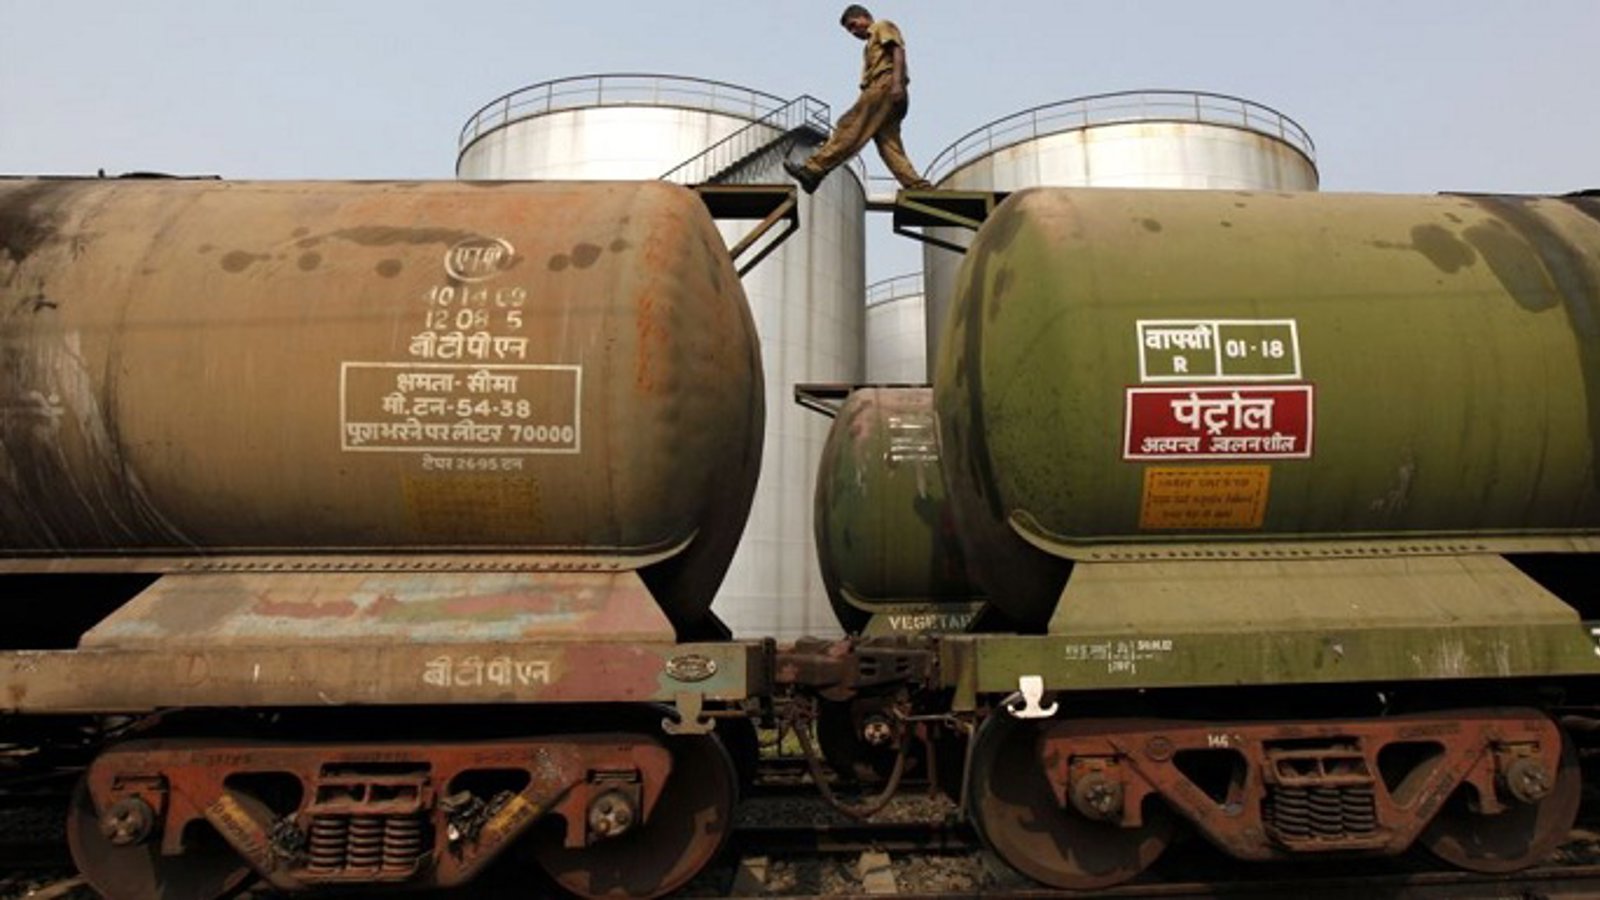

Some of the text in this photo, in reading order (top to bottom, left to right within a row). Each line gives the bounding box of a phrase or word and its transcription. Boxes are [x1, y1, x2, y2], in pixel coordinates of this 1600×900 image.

[1173, 356, 1189, 373] R
[467, 368, 518, 393] सीमा
[1170, 391, 1275, 435] पेट्रोल
[509, 425, 574, 443] 70000
